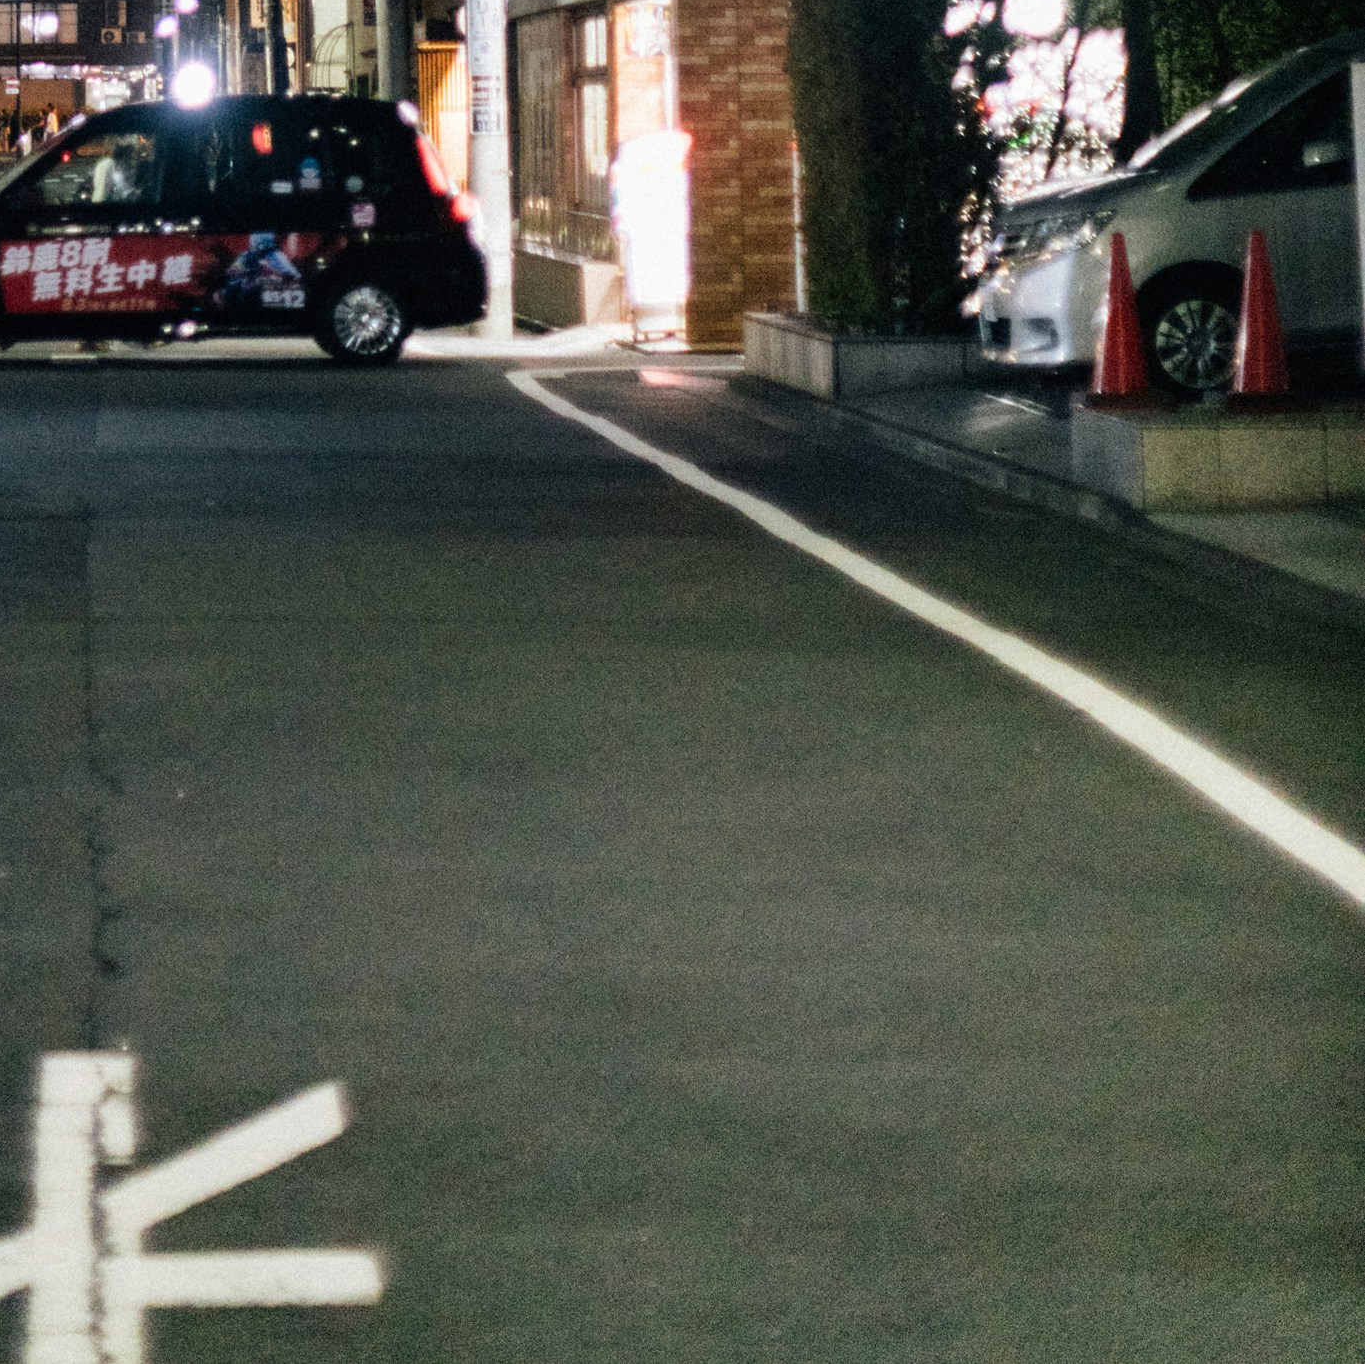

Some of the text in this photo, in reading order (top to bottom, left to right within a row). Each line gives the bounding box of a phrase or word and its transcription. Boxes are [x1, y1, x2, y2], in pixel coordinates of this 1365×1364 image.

[0, 237, 112, 276] 鈴鹿8耐
[32, 253, 194, 303] 無料生中継
